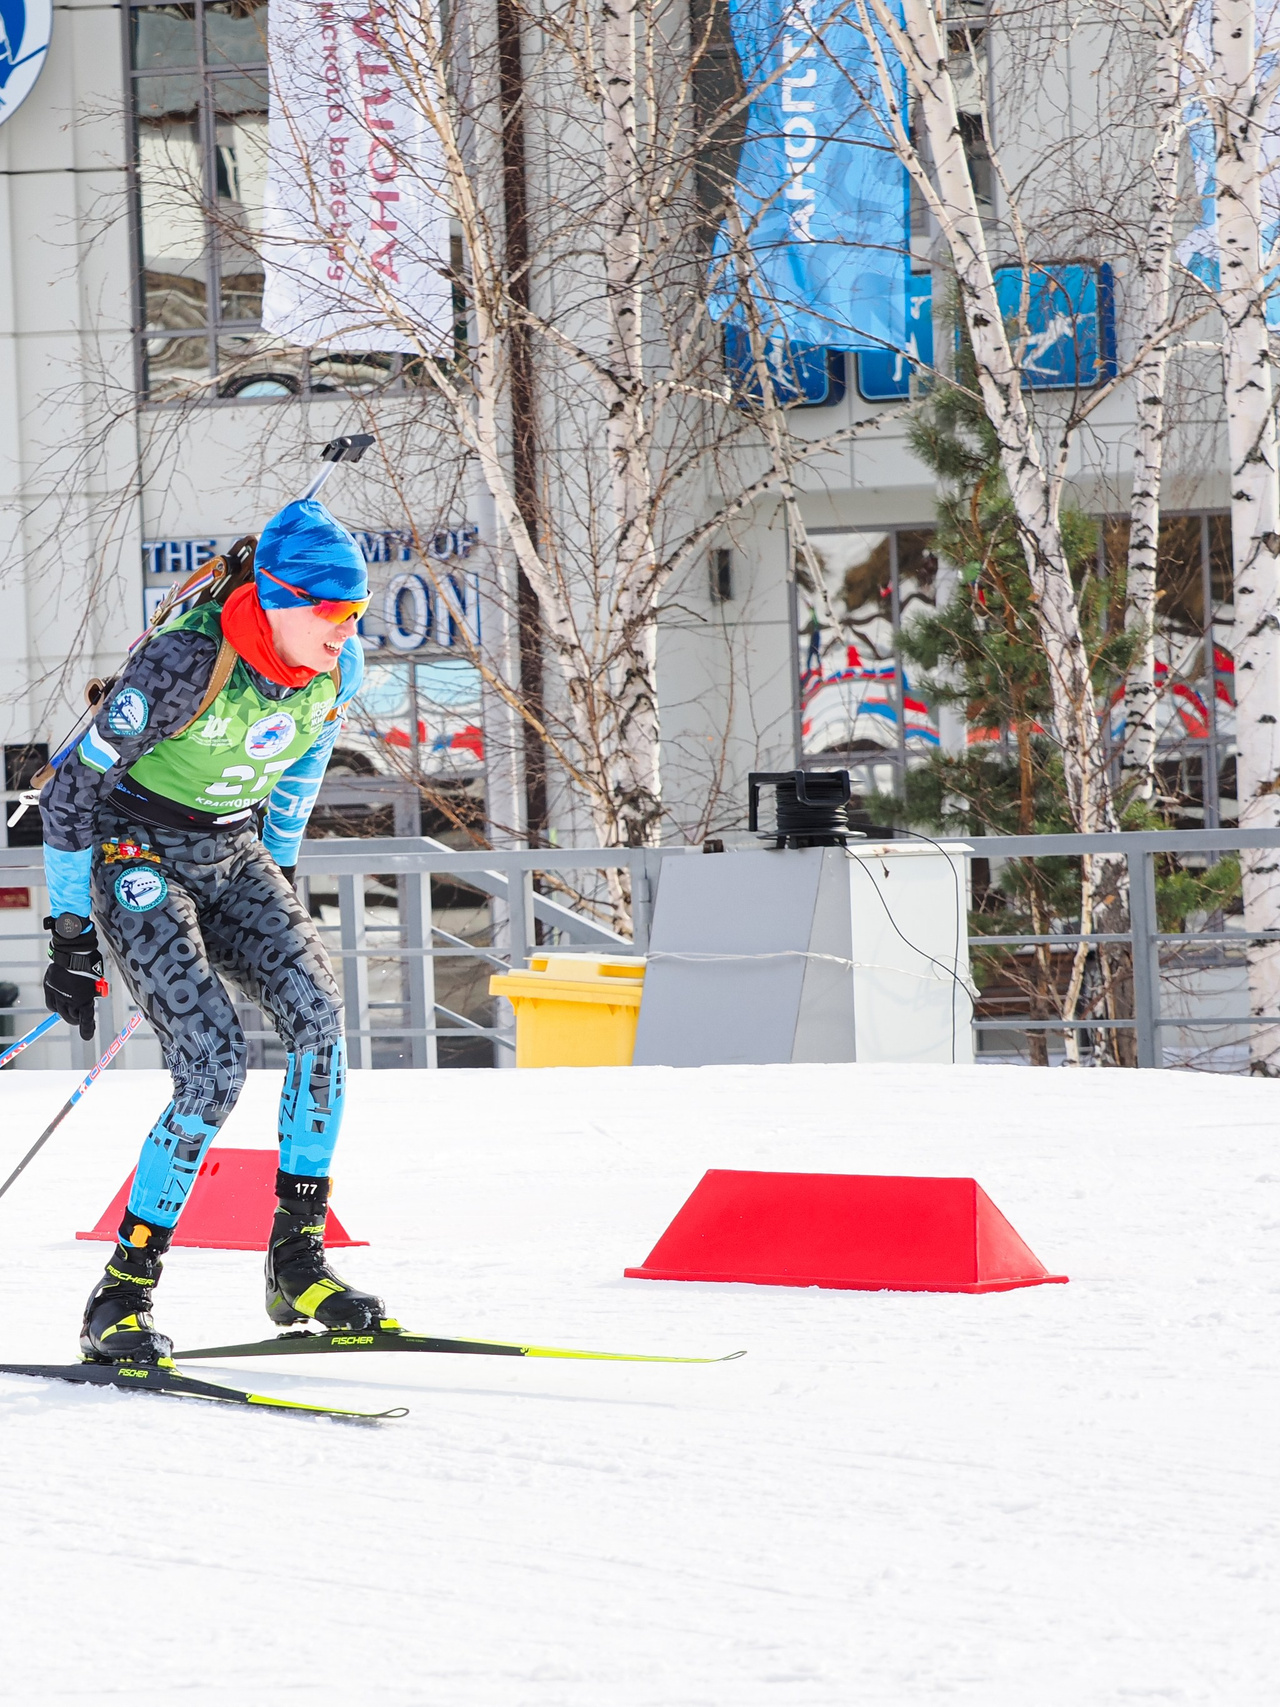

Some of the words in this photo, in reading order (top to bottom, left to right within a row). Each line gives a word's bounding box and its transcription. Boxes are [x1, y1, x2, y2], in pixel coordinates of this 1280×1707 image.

[142, 540, 217, 573] THE
[295, 1183, 318, 1195] 177
[106, 1264, 155, 1286] FISCHER
[331, 1336, 374, 1345] FISCHER
[118, 1369, 149, 1379] FISCHER
